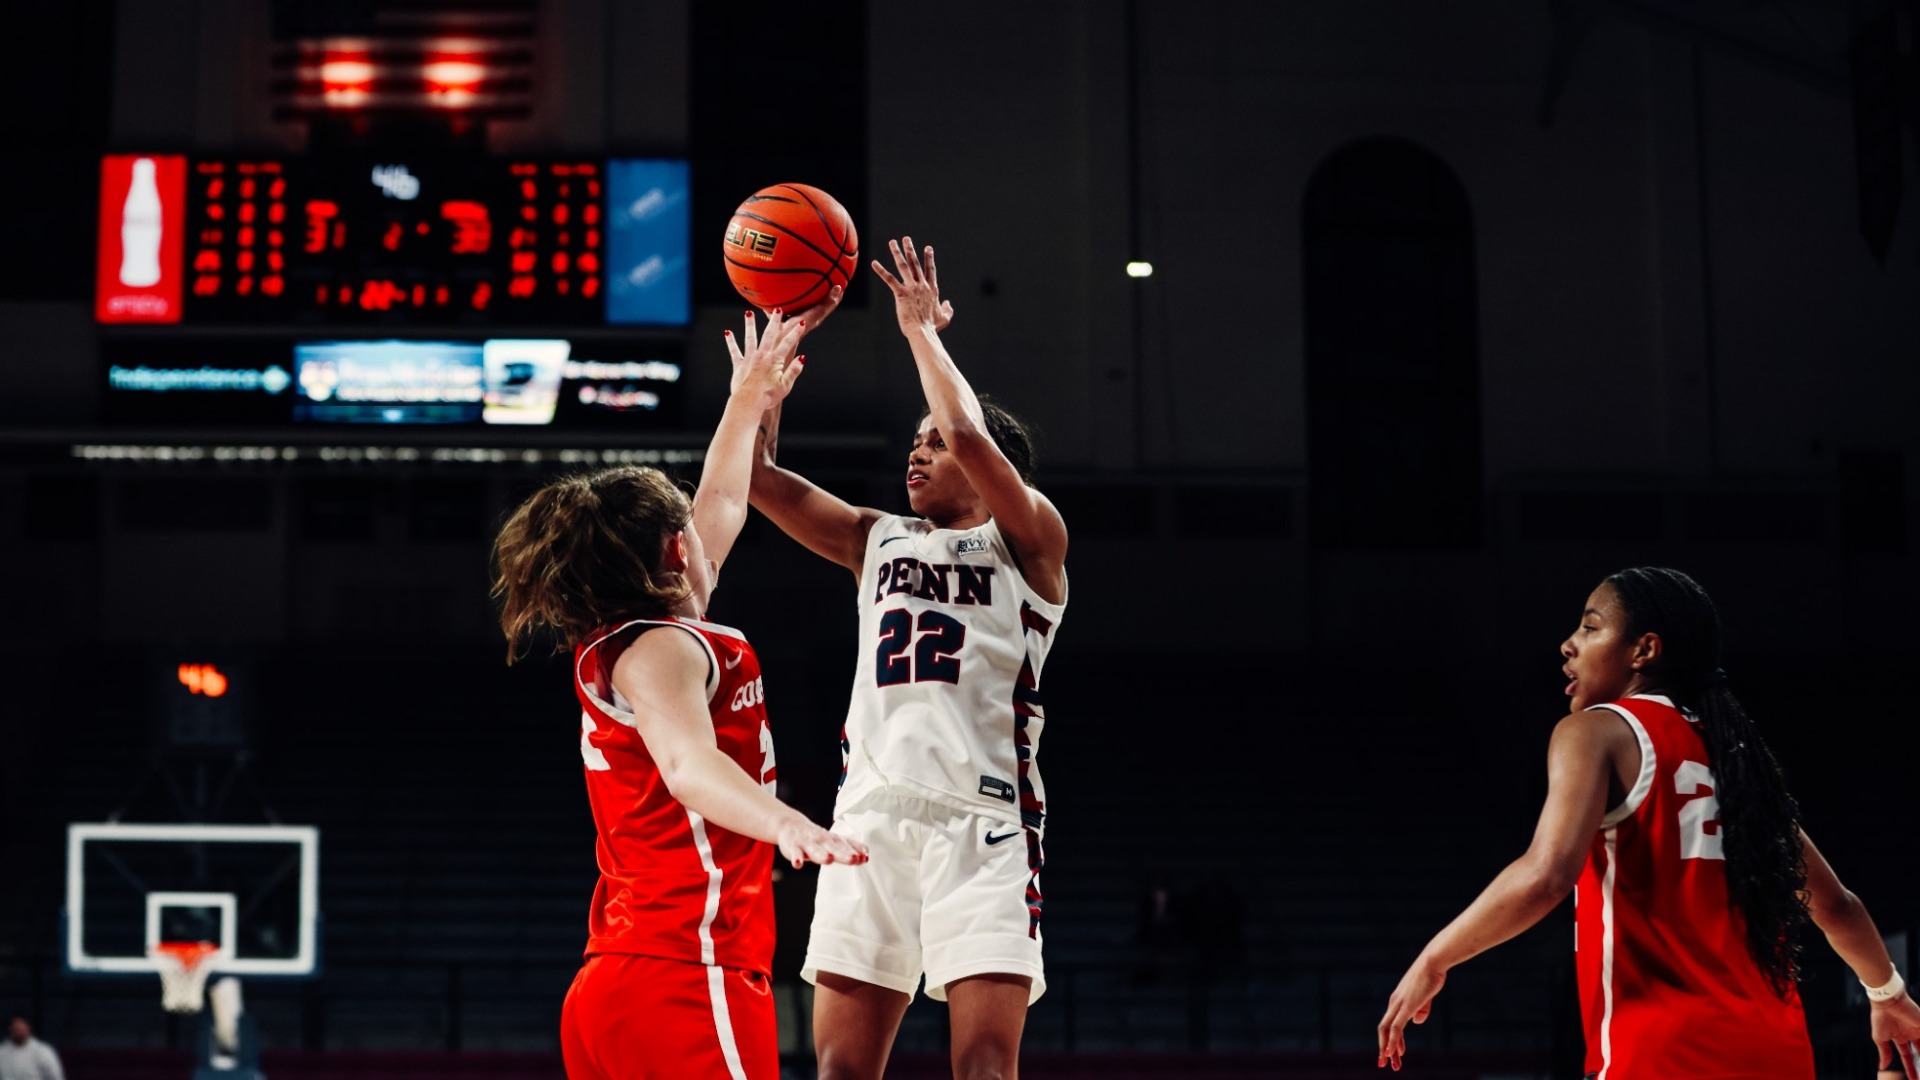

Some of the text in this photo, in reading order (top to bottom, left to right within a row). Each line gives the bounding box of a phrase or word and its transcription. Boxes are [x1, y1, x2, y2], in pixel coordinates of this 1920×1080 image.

[875, 557, 995, 606] PENN
[178, 663, 229, 697] 46
[876, 607, 966, 688] 22
[1673, 760, 1727, 861] 2
